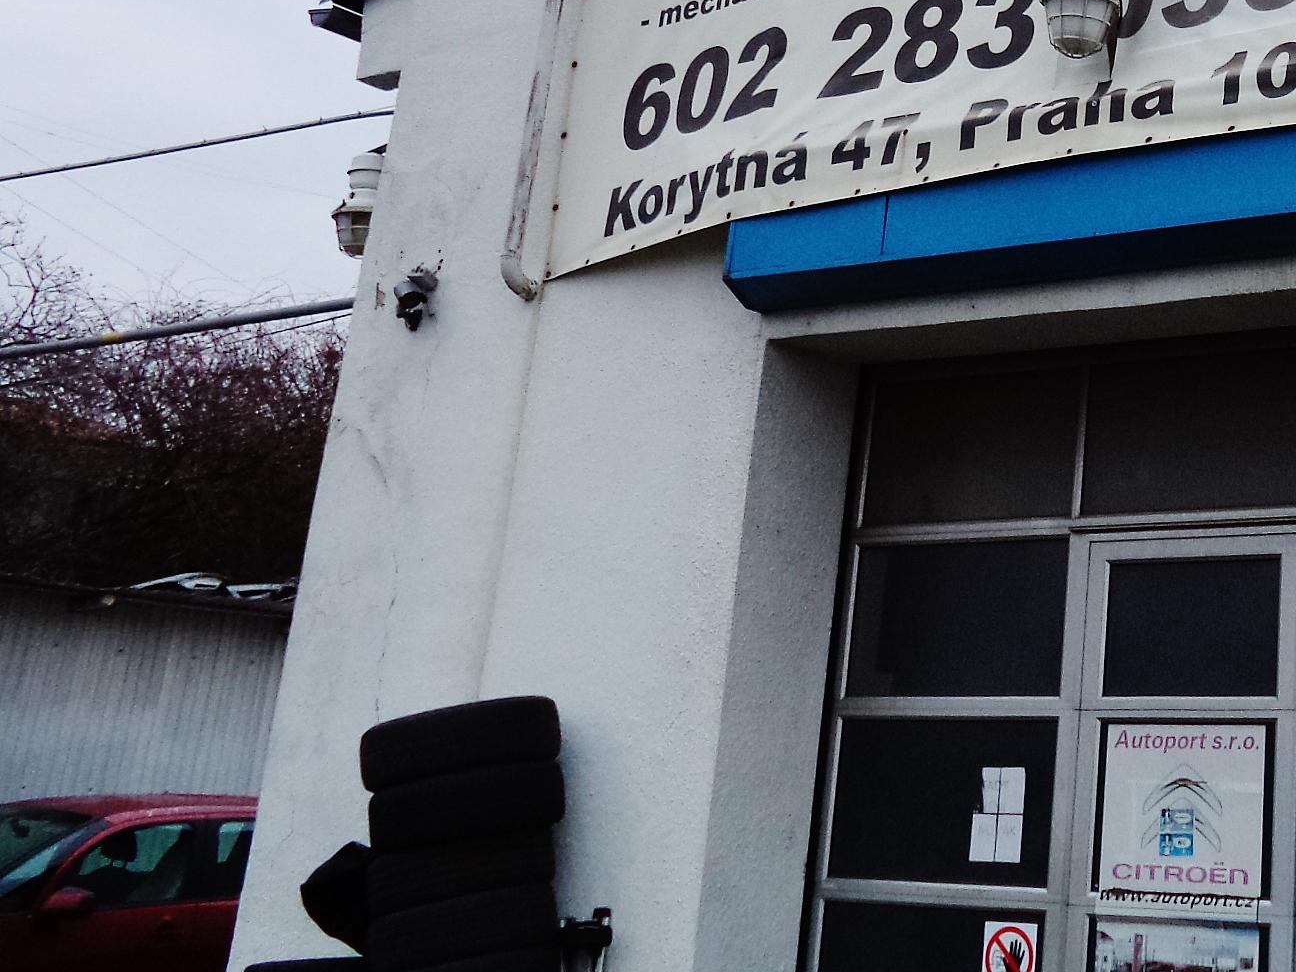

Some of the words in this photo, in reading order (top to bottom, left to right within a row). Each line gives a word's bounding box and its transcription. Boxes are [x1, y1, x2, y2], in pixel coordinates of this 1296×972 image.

[622, 26, 788, 151] 602
[603, 131, 809, 238] Korytná
[831, 112, 932, 174] 47,
[959, 78, 1176, 151] Praha
[1114, 729, 1207, 754] Autoport
[1212, 737, 1260, 752] s.r.o.
